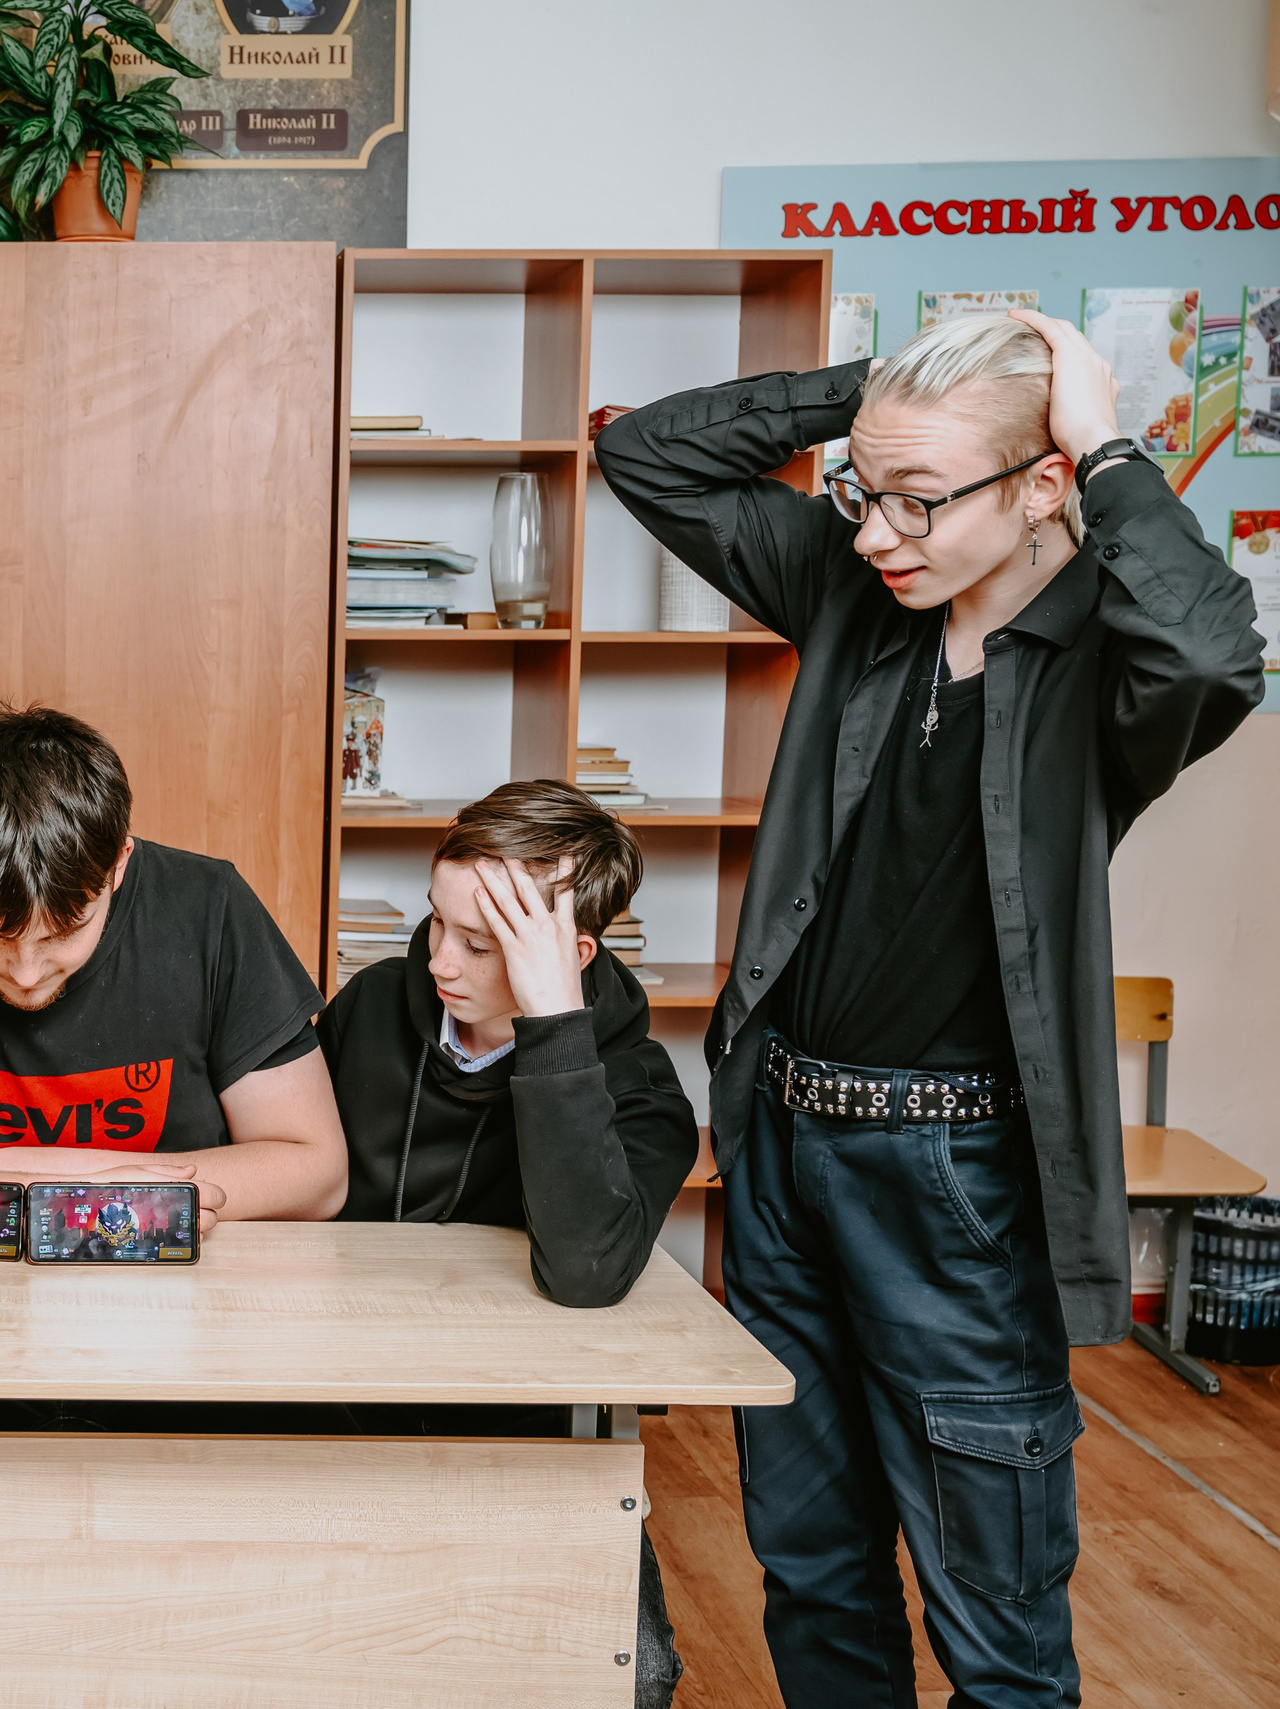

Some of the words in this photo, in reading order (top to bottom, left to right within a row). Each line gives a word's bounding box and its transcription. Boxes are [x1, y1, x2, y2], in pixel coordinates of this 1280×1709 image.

[228, 45, 320, 65] Николай
[328, 45, 348, 65] II
[248, 113, 317, 130] Николай
[321, 113, 337, 130] II
[781, 188, 1098, 238] КЛАССНЫЙ
